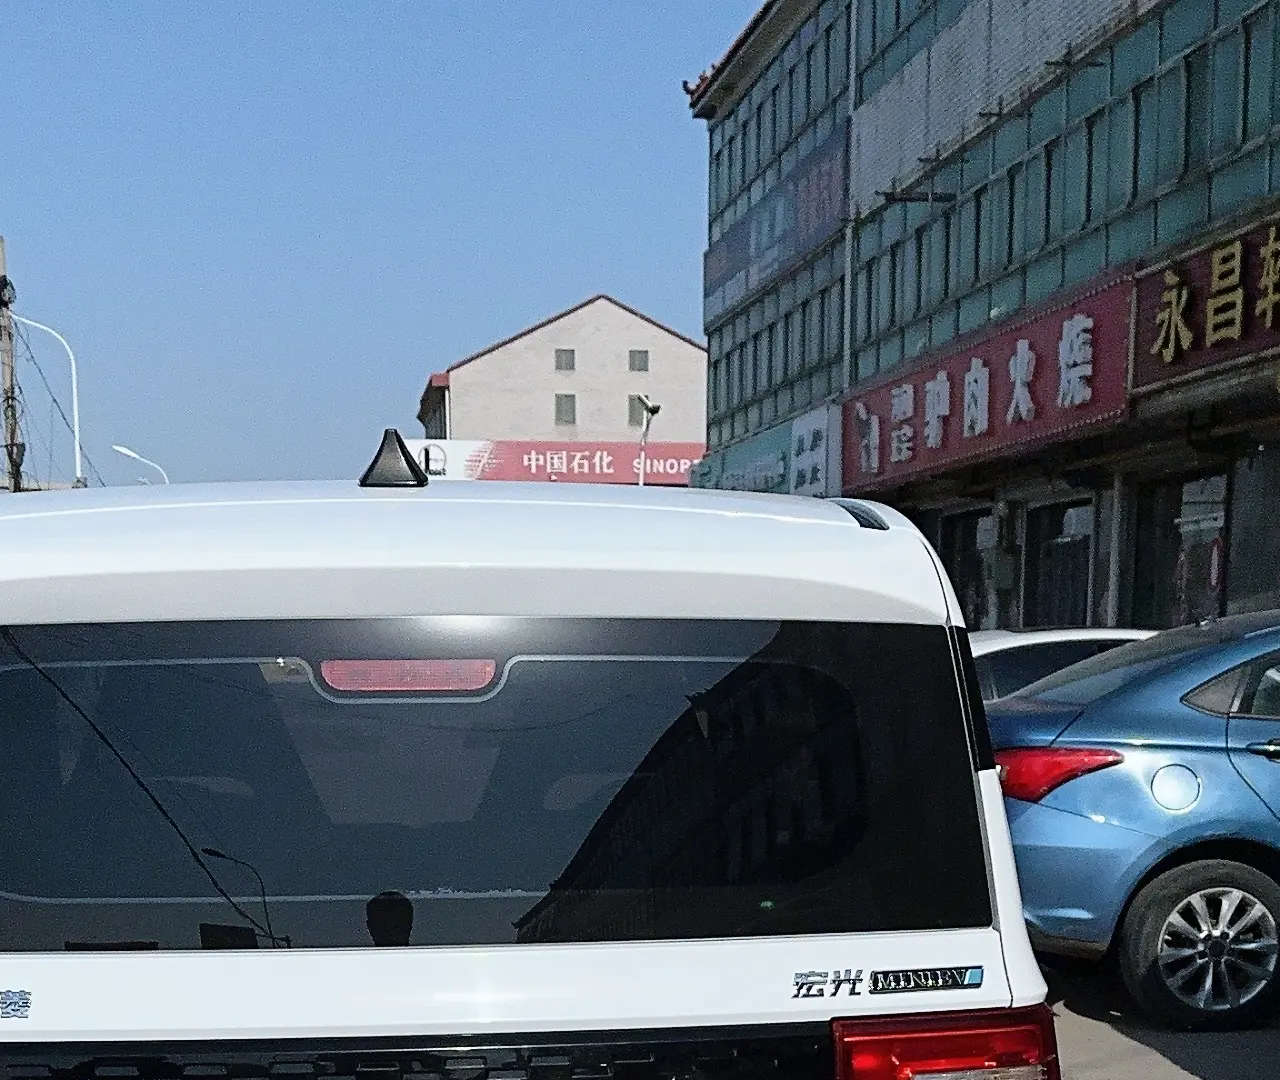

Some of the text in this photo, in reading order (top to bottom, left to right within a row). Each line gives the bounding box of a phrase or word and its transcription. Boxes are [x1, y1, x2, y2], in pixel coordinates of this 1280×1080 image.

[523, 449, 614, 475] 中国石化
[632, 457, 702, 475] SINOP
[791, 969, 864, 999] 宏光
